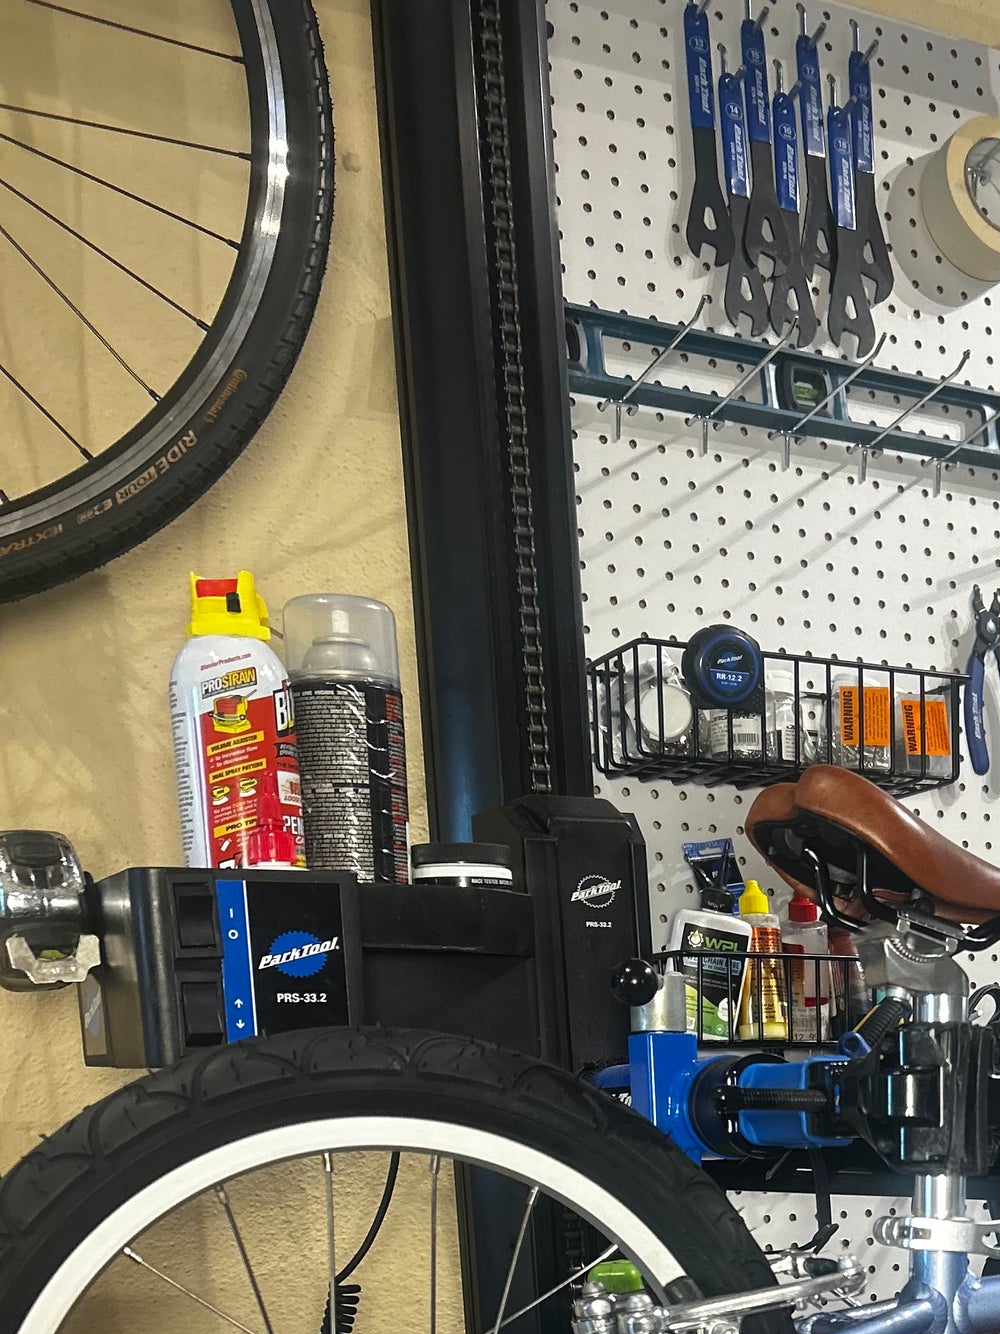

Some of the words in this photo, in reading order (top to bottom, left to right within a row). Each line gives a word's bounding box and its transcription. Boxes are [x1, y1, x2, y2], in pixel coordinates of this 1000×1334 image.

[158, 430, 198, 474] RIDE
[716, 673, 743, 682] RR-12.2
[843, 690, 854, 741] WARNING
[904, 704, 918, 752] WARNING
[226, 823, 242, 832] PRO
[276, 992, 328, 1004] PRS-33.2
